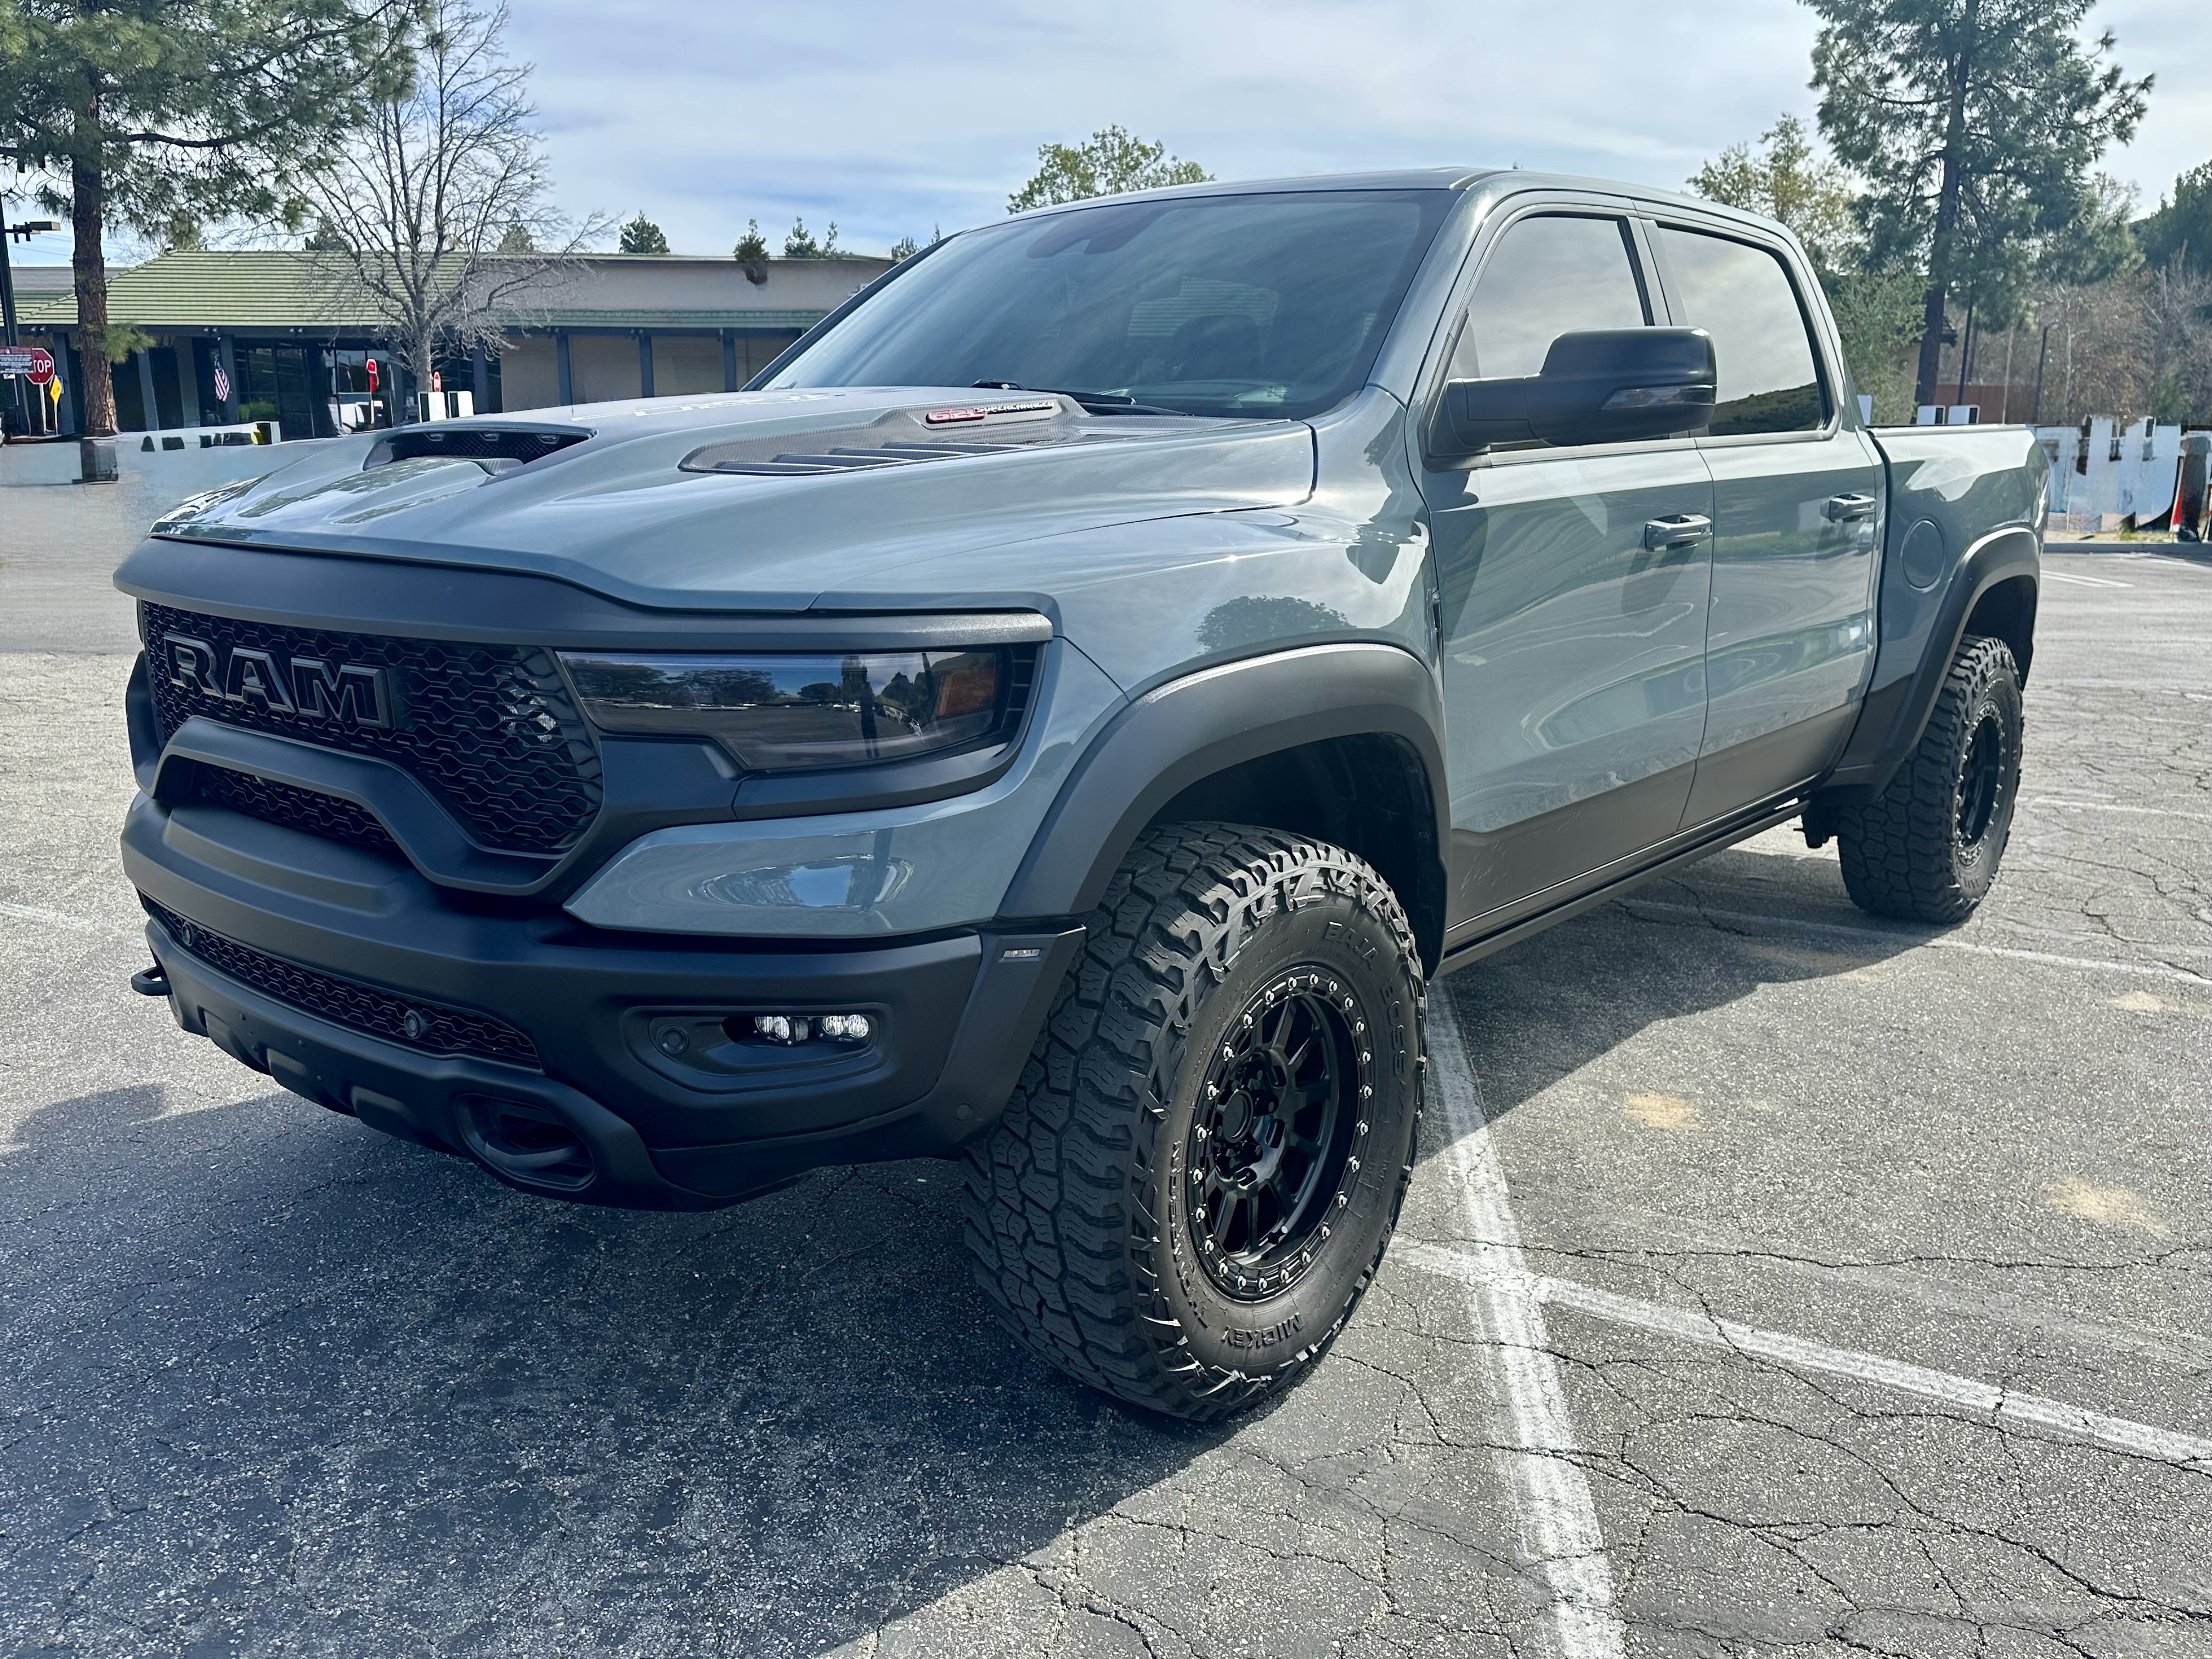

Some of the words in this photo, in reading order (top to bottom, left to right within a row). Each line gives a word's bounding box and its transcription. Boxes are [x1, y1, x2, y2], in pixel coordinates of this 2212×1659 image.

[33, 359, 52, 373] TOP
[165, 631, 394, 728] RAM
[1323, 921, 1379, 970] BAJA
[1380, 979, 1407, 1076] BOSS
[1221, 1312, 1305, 1348] MICKEY
